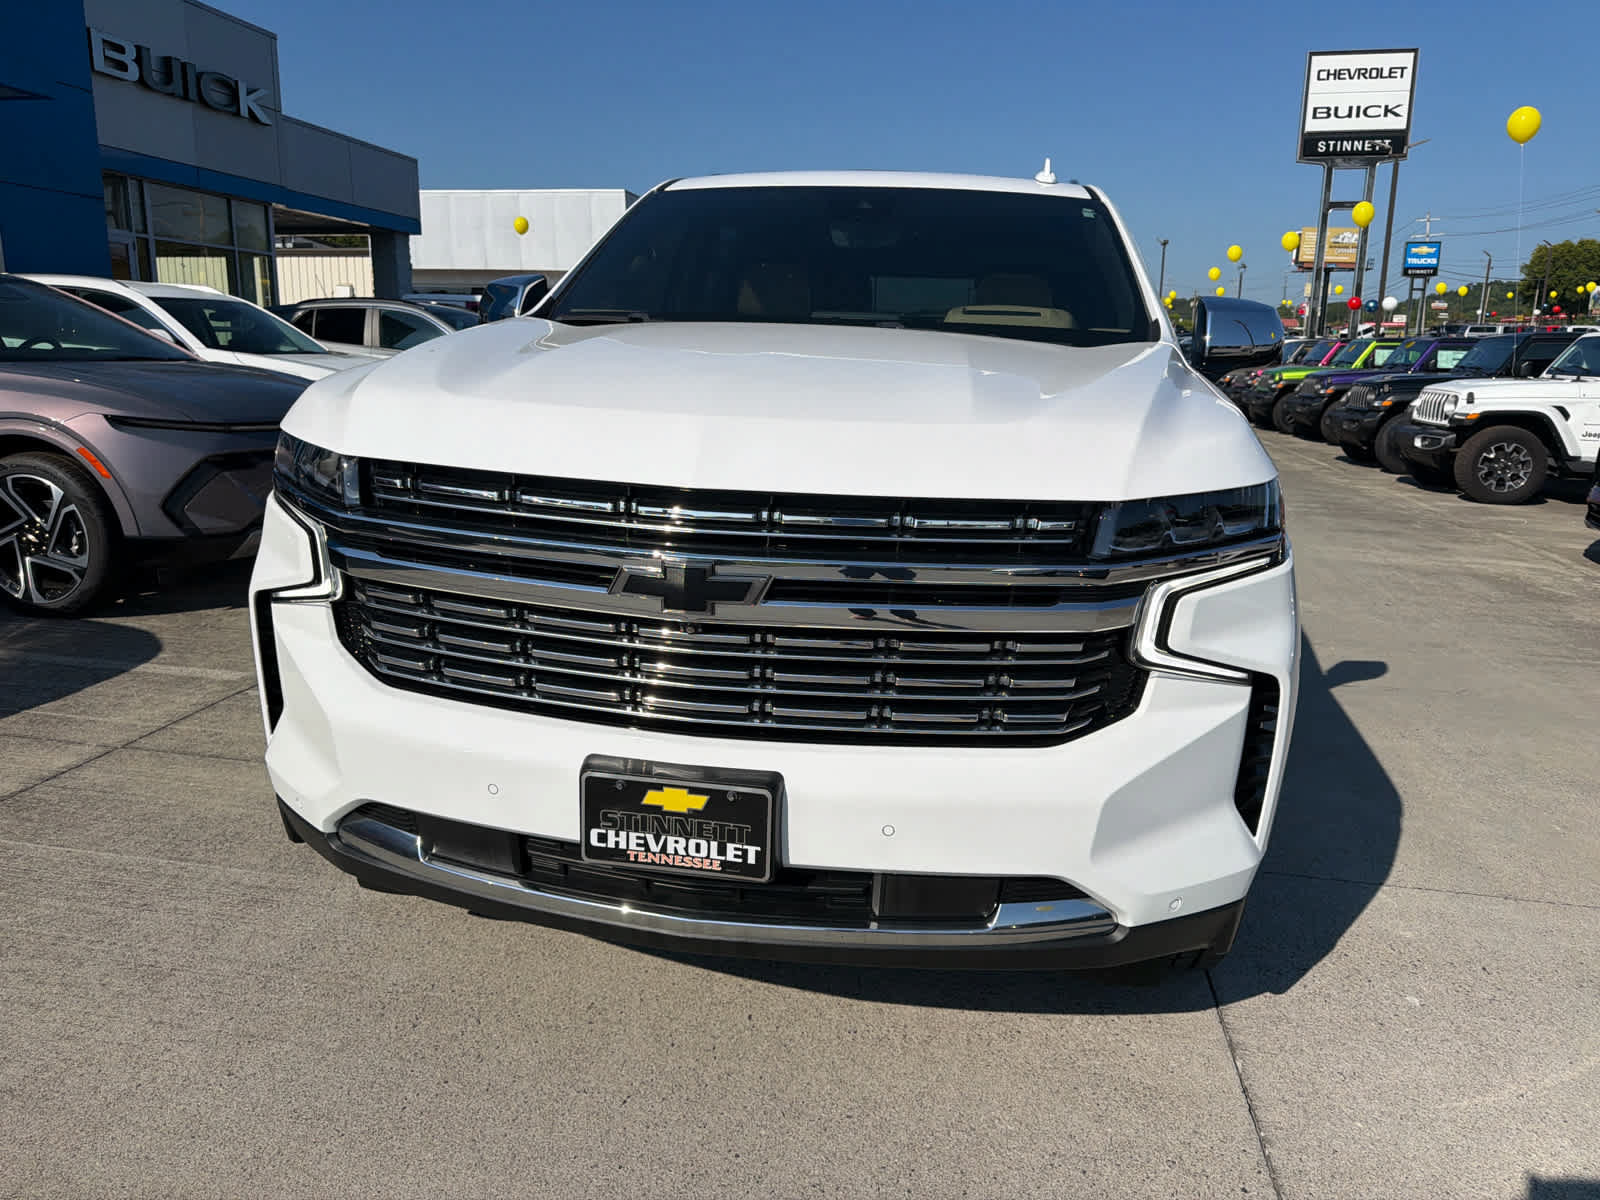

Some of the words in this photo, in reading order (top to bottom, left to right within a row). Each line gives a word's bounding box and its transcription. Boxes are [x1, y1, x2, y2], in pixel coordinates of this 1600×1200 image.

[88, 26, 272, 126] BUICK
[1317, 66, 1408, 81] CHEVROLET
[1312, 104, 1403, 119] BUICK
[600, 810, 752, 844] STINNETT
[590, 828, 761, 864] CHEVROLET
[627, 850, 722, 871] TENNESSEE
